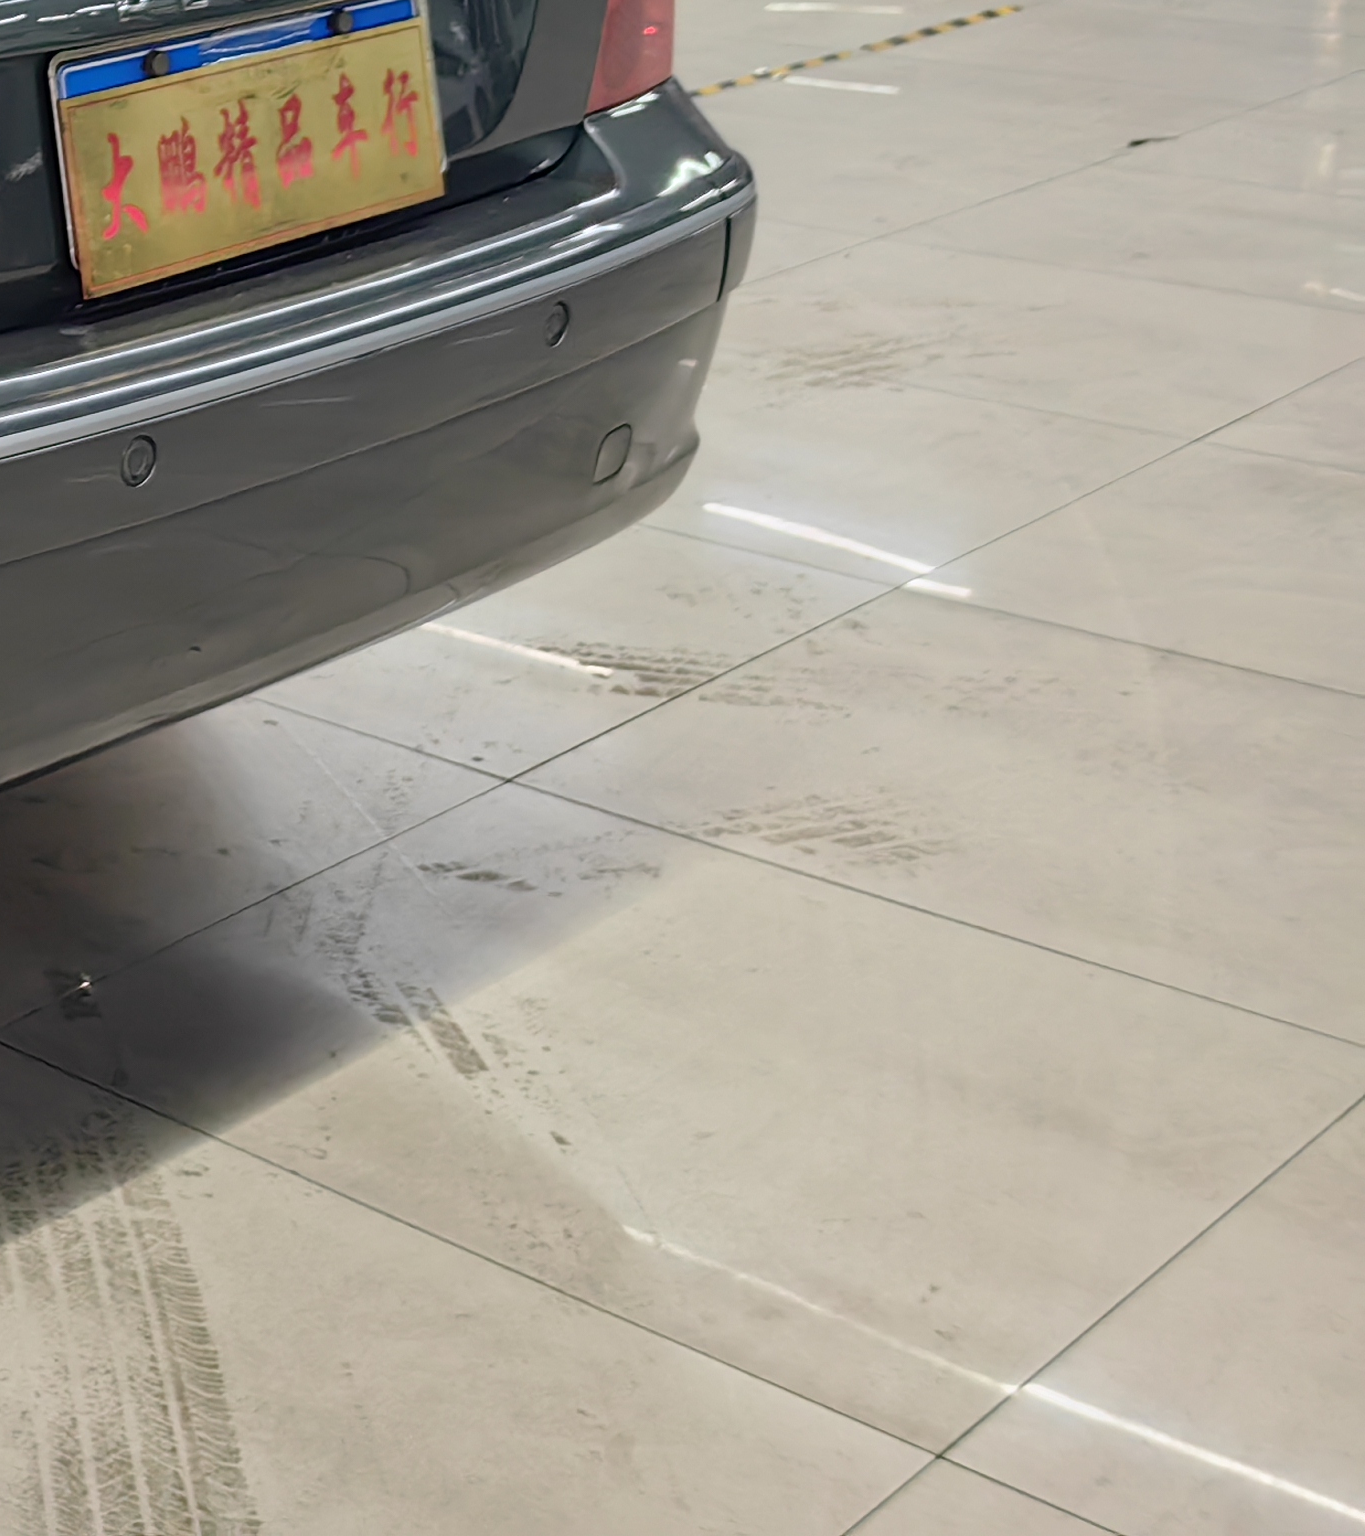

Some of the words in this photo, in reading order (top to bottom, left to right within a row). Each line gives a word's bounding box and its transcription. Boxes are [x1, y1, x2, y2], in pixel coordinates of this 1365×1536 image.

[101, 68, 421, 241] 大鹏精品车行
